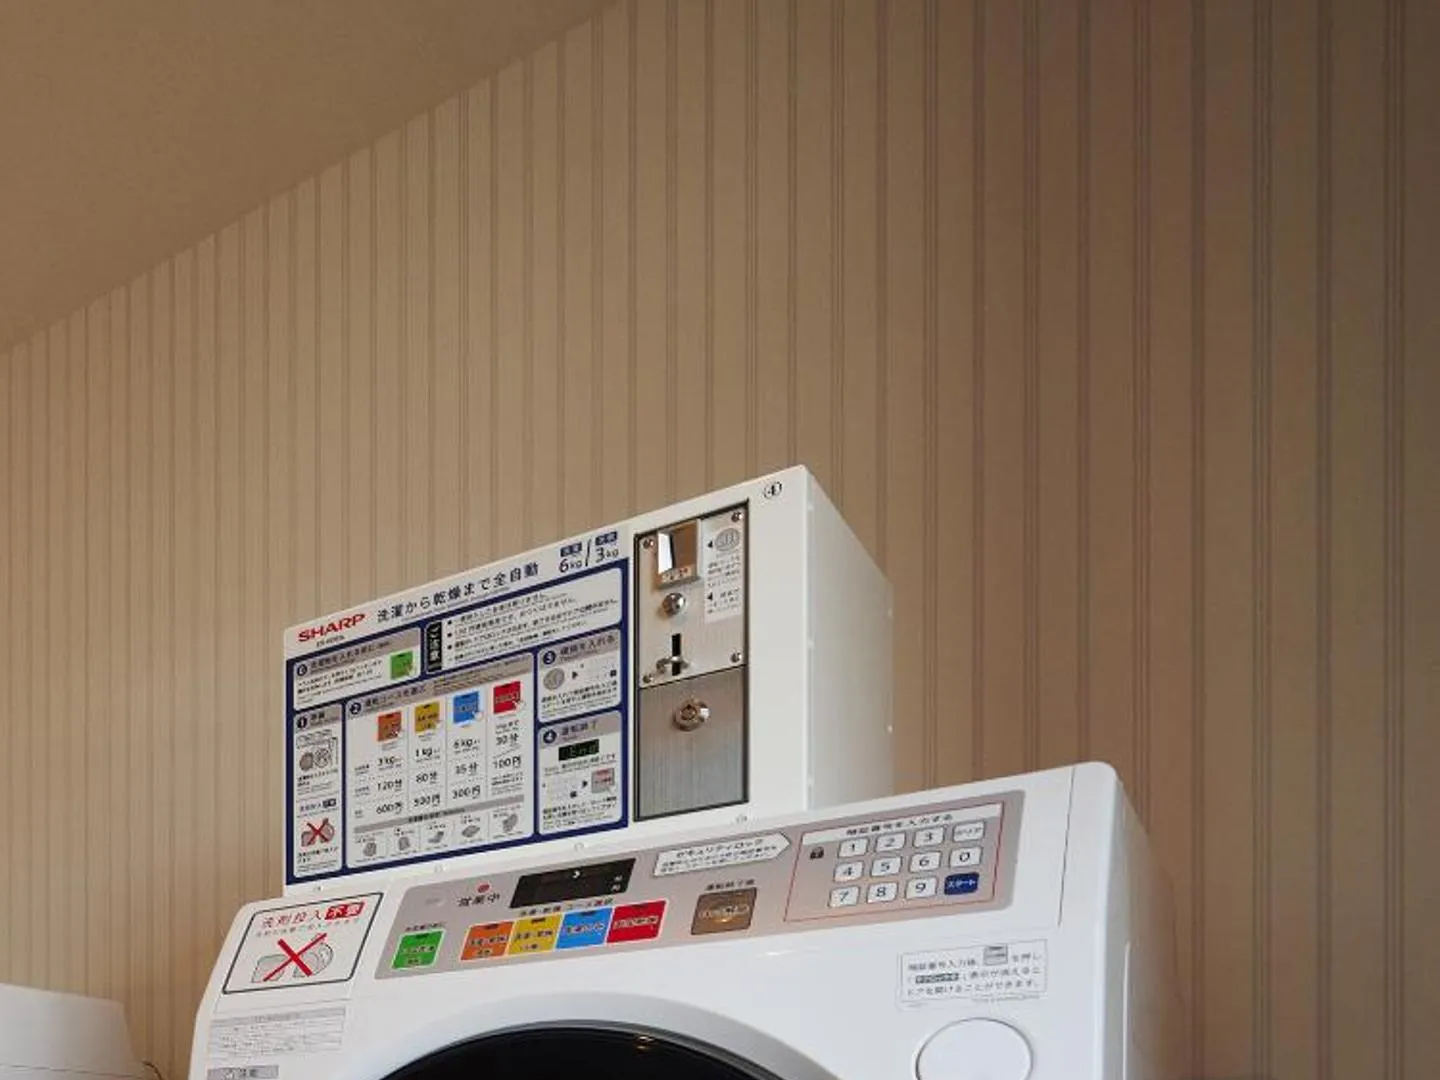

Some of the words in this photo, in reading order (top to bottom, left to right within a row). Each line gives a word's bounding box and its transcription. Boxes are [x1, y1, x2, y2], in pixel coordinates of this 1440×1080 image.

[376, 562, 539, 623] 洗濯から乾燥まで全自動
[297, 613, 365, 642] SHARP
[885, 838, 896, 848] 2
[923, 833, 933, 842] 3
[843, 867, 853, 877] 4
[880, 862, 890, 871] 5
[919, 856, 929, 866] 6
[959, 852, 971, 862] 0
[839, 891, 849, 902] 7
[875, 886, 887, 897] 8
[915, 882, 926, 893] 9
